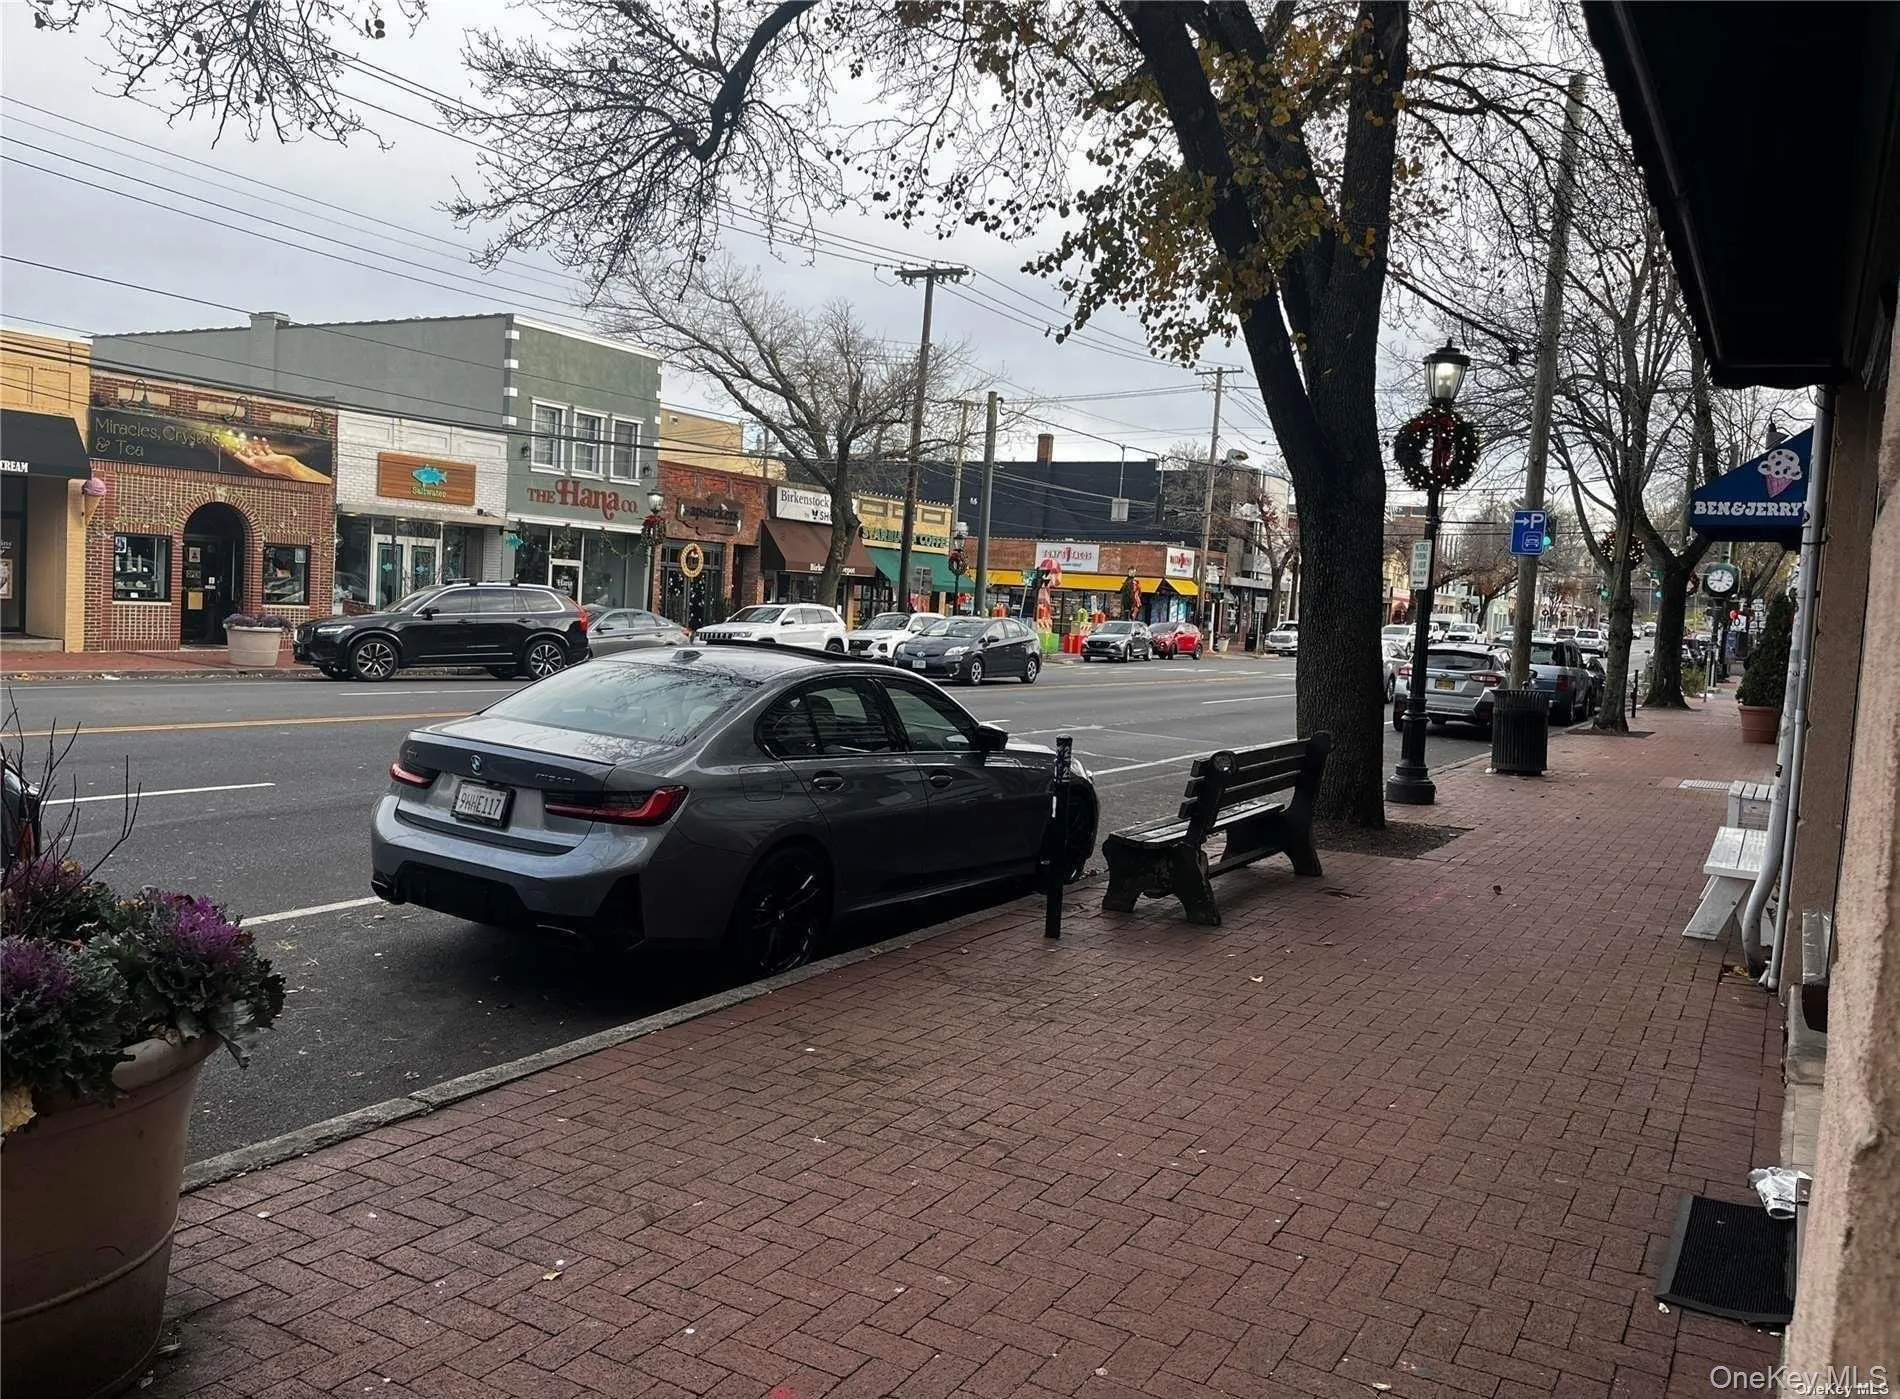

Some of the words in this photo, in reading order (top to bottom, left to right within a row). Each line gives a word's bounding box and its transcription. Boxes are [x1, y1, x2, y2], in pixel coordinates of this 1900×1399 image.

[95, 417, 161, 441] Miracles,
[95, 437, 110, 453] &
[115, 440, 144, 457] Tea
[526, 487, 556, 504] THE
[555, 478, 620, 520] Hana
[781, 489, 830, 508] Birkenstock
[1530, 513, 1545, 529] P
